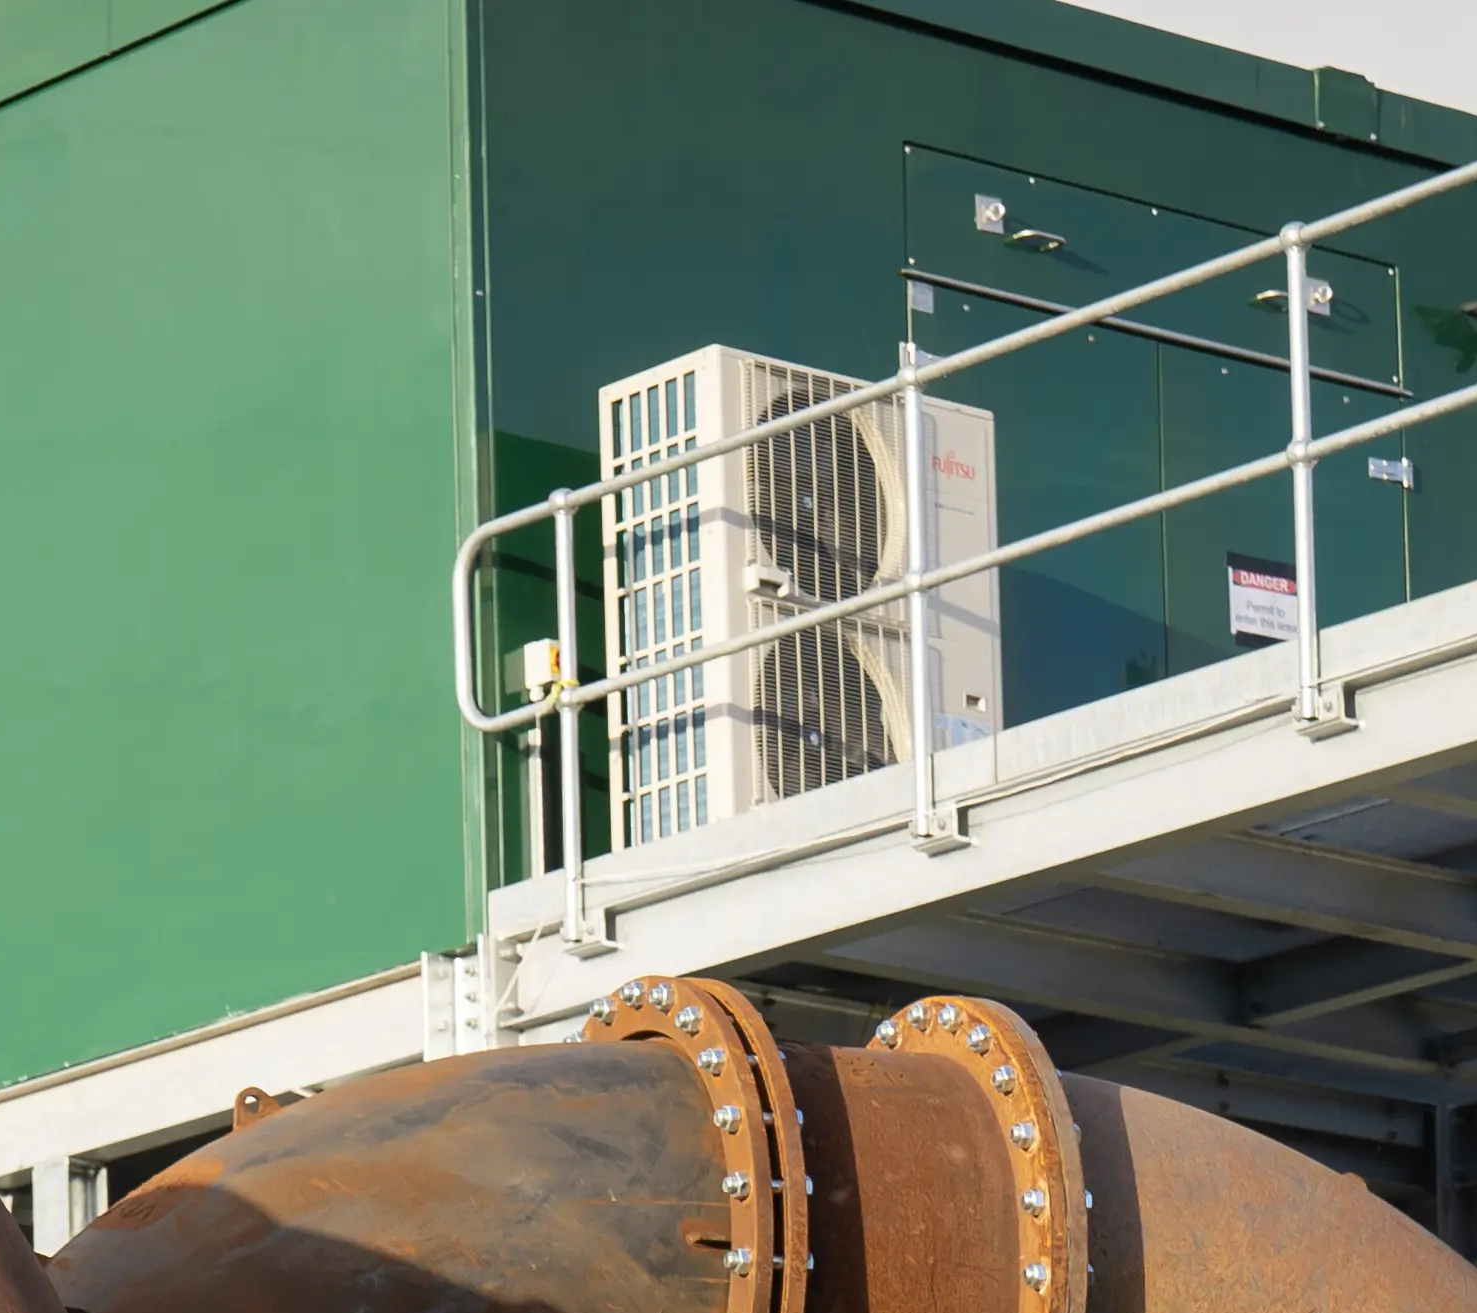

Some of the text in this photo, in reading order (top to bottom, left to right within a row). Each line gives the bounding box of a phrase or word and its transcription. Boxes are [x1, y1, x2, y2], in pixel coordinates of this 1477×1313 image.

[932, 454, 976, 481] FUJITSU
[1239, 569, 1289, 592] DANGER
[1246, 599, 1286, 619] Permit to
[1259, 616, 1276, 631] this
